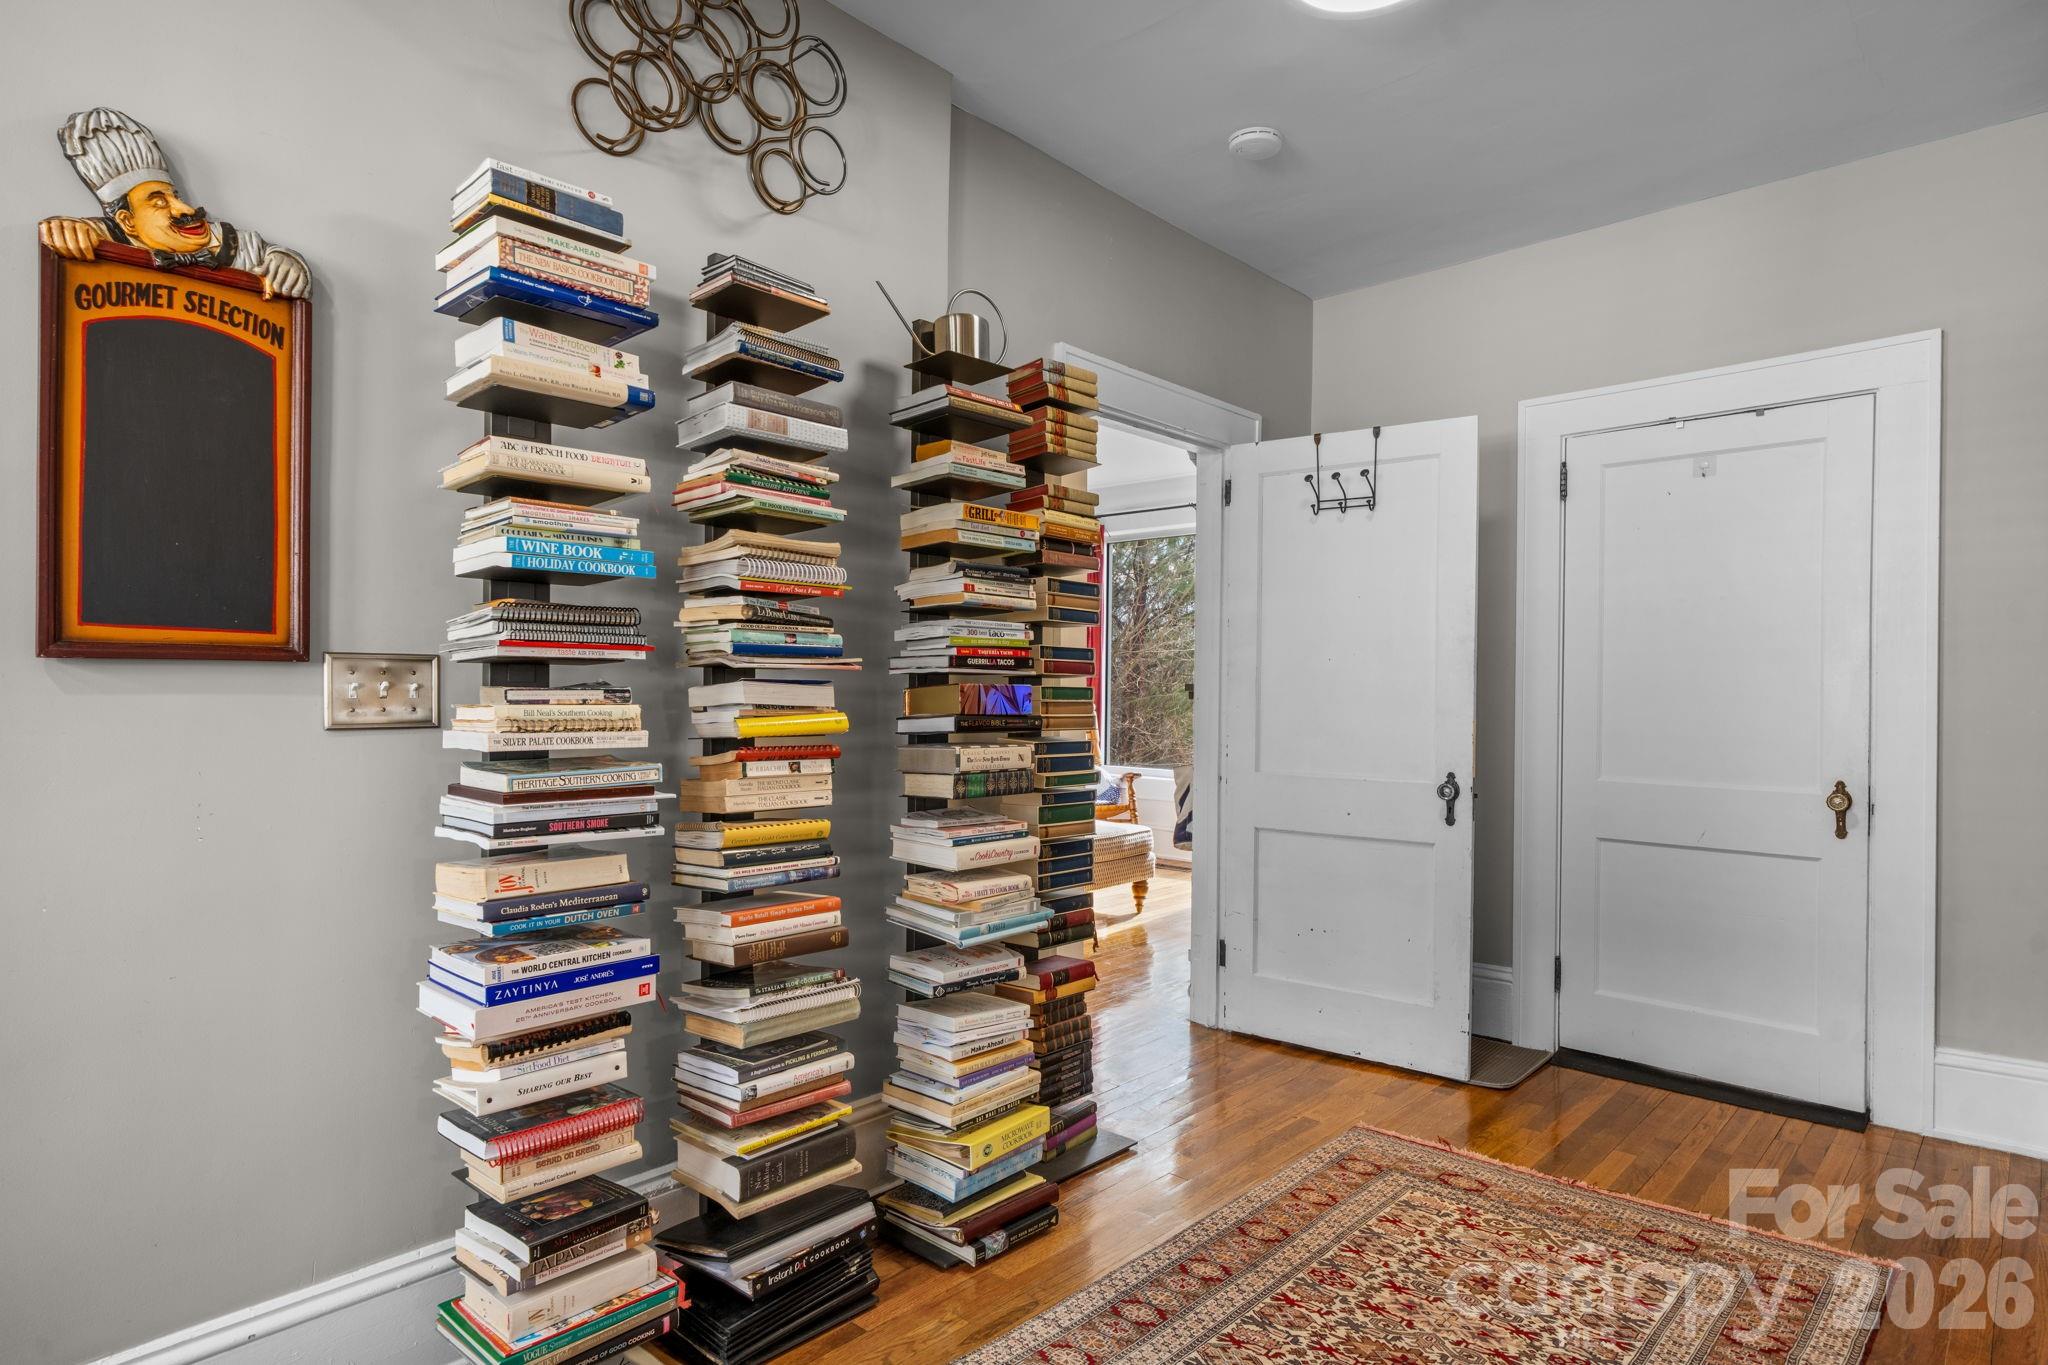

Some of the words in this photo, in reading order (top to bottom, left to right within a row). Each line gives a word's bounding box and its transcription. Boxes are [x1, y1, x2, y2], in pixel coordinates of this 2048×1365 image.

[546, 236, 600, 259] MAKE-AHEAD
[518, 251, 534, 265] THE
[552, 260, 576, 276] BASICS
[577, 267, 616, 288] COOKBOOK
[74, 281, 178, 311] GOURMET
[183, 290, 286, 350] SELECTION
[560, 335, 598, 355] Protocol
[500, 440, 519, 452] ABC
[530, 445, 562, 458] FRENCH
[564, 451, 588, 462] FOOD
[532, 516, 573, 530] smoothies
[968, 505, 996, 522] GRILL
[521, 540, 560, 556] WINE
[562, 544, 602, 560] BOOK
[526, 555, 574, 572] HOLIDAY
[578, 559, 636, 578] COOKBOOK
[966, 628, 978, 636] 300
[987, 629, 1005, 638] taco
[966, 657, 997, 665] GUERRILLA
[536, 709, 556, 717] Neal's
[557, 709, 585, 717] Southern
[586, 709, 612, 718] Cooking
[990, 718, 1006, 726] BIBLE
[502, 737, 526, 746] SILVER
[528, 736, 554, 745] PALATE
[556, 735, 594, 745] COOKBOOK
[517, 778, 558, 789] HERITAGE
[558, 772, 600, 786] SOUTHERN
[602, 771, 636, 782] COOKING
[548, 819, 584, 831] SOUTHERN
[586, 817, 608, 828] SMOKE
[990, 848, 1014, 860] Country
[977, 889, 988, 898] HATE
[989, 888, 995, 896] TO
[995, 886, 1008, 894] COOK
[1008, 884, 1020, 893] BOOK
[500, 904, 528, 915] Claudia
[530, 900, 558, 911] Roden's
[559, 892, 618, 907] Mediterranean
[510, 923, 526, 931] COOK
[544, 917, 560, 925] YOUR
[564, 911, 594, 924] DUTCH
[596, 907, 619, 918] OVEN
[520, 962, 547, 974] WORLD
[548, 956, 580, 968] CENTRAL
[582, 951, 610, 962] KITCHEN
[612, 948, 632, 956] COOKBOOK
[985, 964, 1009, 972] REVOLUTION
[574, 973, 588, 983] JOSÉ
[762, 982, 784, 993] ITALIAN
[785, 979, 799, 988] SLOW
[800, 974, 820, 985] COOKER
[525, 1001, 564, 1014] AMERICA'S
[566, 997, 582, 1005] TEST
[584, 991, 614, 1001] KITCHEN
[532, 1004, 582, 1018] ANNIVERSARY
[584, 995, 622, 1007] COOKBOOK
[962, 1048, 970, 1056] The
[970, 1040, 1004, 1053] Make-Ahead
[1004, 1035, 1015, 1044] Cook
[553, 1053, 570, 1064] Diet
[785, 1056, 806, 1067] PICKLING
[810, 1046, 838, 1059] FERMENTING
[793, 1066, 825, 1081] America's
[984, 1109, 998, 1119] WHAT
[1001, 1120, 1035, 1142] MICROWAVE
[1002, 1130, 1033, 1150] COOKBOOK
[533, 1176, 556, 1187] Practical
[556, 1169, 576, 1180] Cookery
[776, 1160, 784, 1183] Cook
[531, 1243, 586, 1276] TAPAS
[768, 1268, 794, 1286] Instant
[794, 1260, 807, 1274] Pot
[809, 1237, 850, 1264] COOKBOOK
[608, 1340, 627, 1354] GOOD
[628, 1327, 655, 1345] COOKING
[523, 1344, 548, 1362] VOGUE
